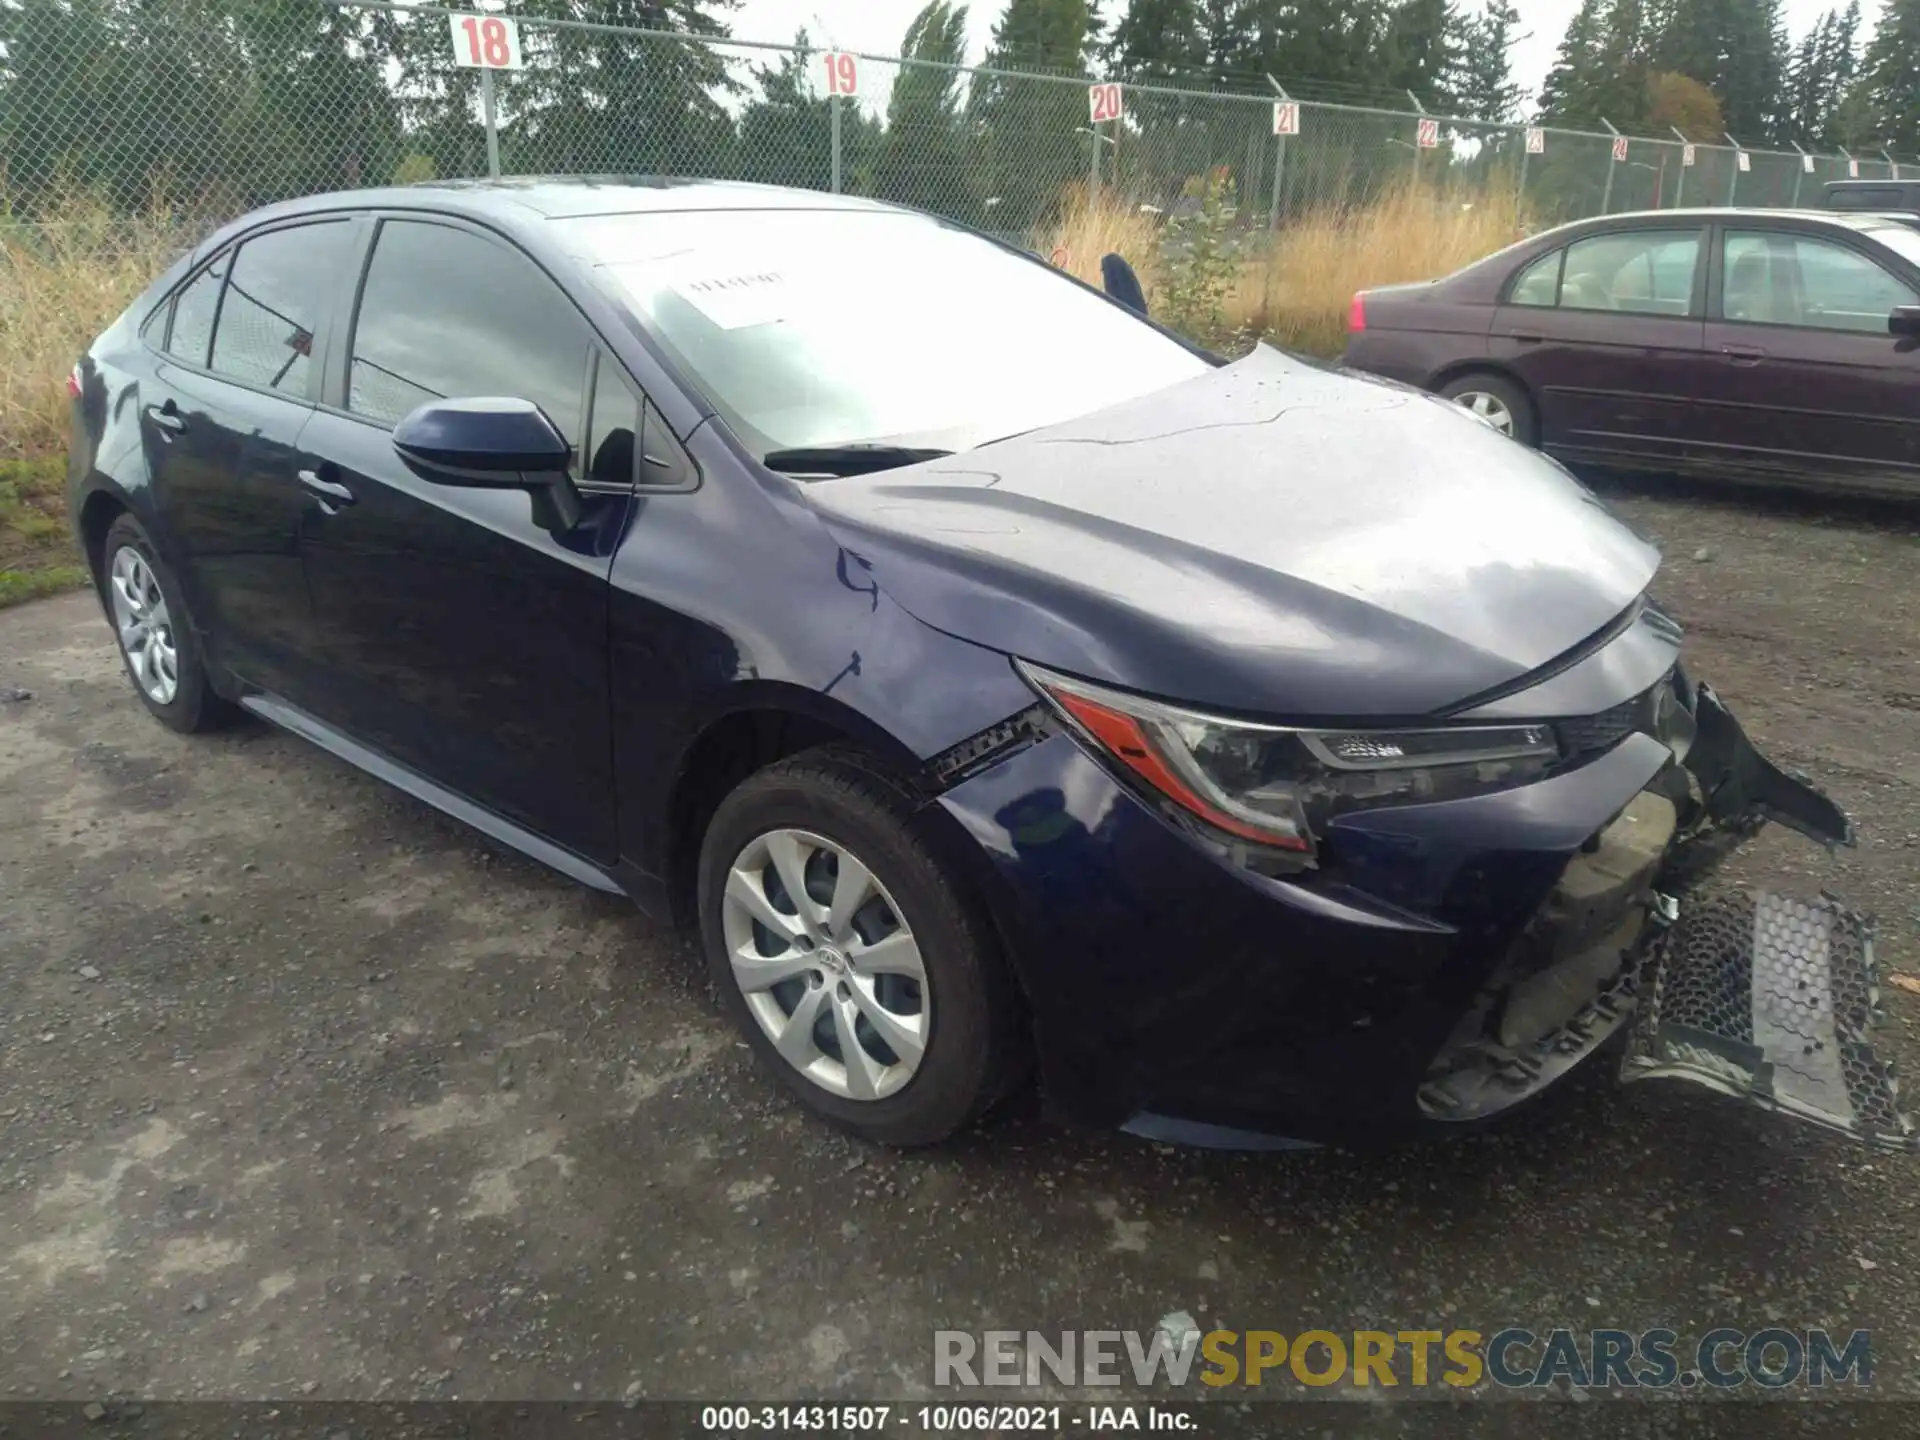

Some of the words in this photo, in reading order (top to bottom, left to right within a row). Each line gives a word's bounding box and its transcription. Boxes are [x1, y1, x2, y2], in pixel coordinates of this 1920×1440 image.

[462, 17, 509, 66] 18
[824, 54, 856, 94] 19
[1092, 85, 1119, 119] 20
[1278, 106, 1295, 132] 21
[1420, 121, 1436, 145] 22
